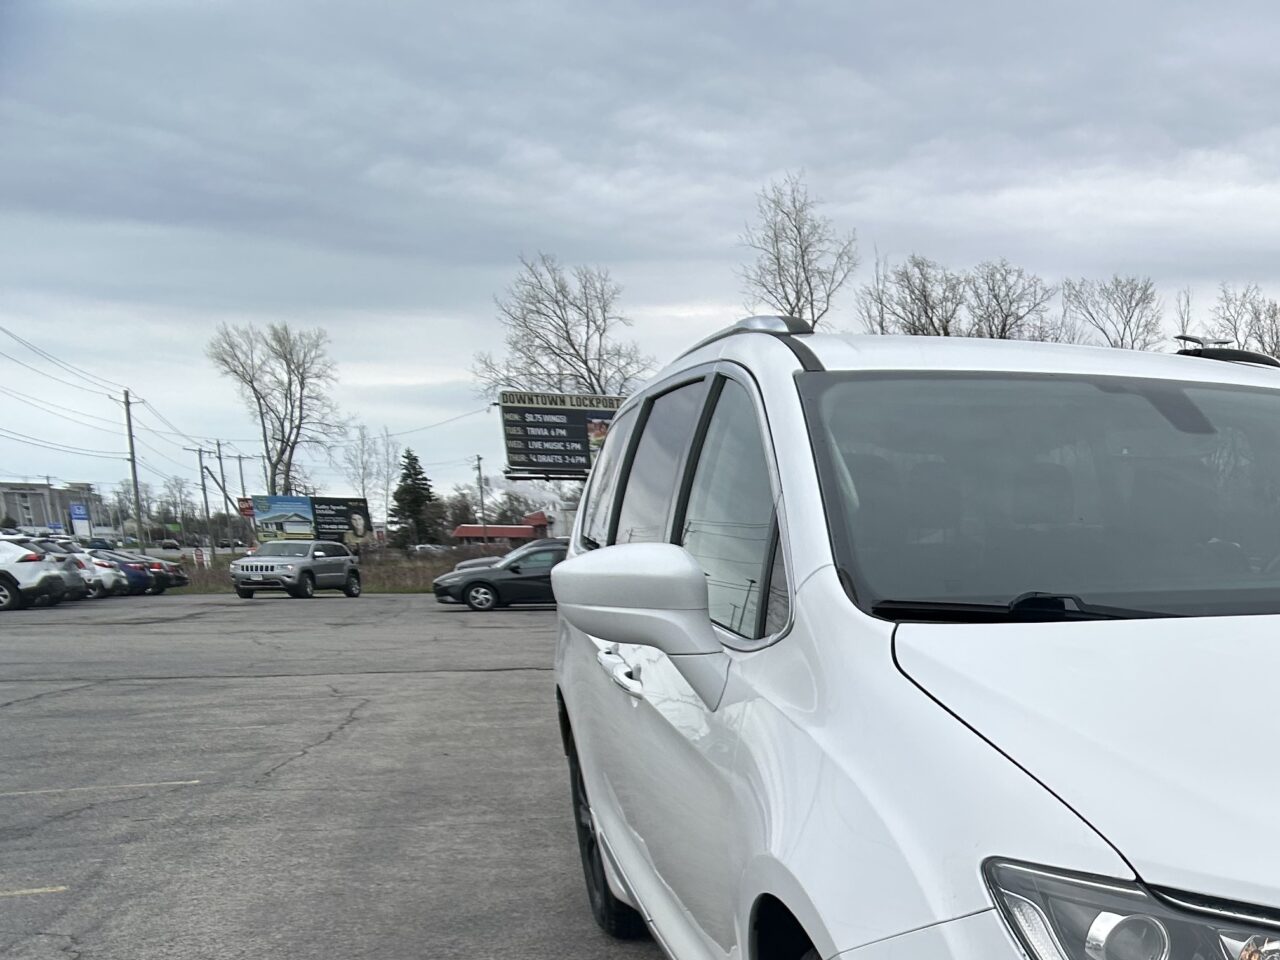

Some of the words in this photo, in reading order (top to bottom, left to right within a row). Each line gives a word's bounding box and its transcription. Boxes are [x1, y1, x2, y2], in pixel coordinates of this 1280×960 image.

[502, 393, 566, 406] DOWNTOWN
[569, 396, 621, 409] LOCKPORT
[526, 427, 549, 436] TRIVIA
[556, 428, 567, 437] PM
[528, 441, 542, 449] LIVE
[543, 442, 565, 450] MUSIC
[571, 443, 581, 451] PM
[537, 455, 563, 463] DRAFTS
[575, 456, 587, 464] PM
